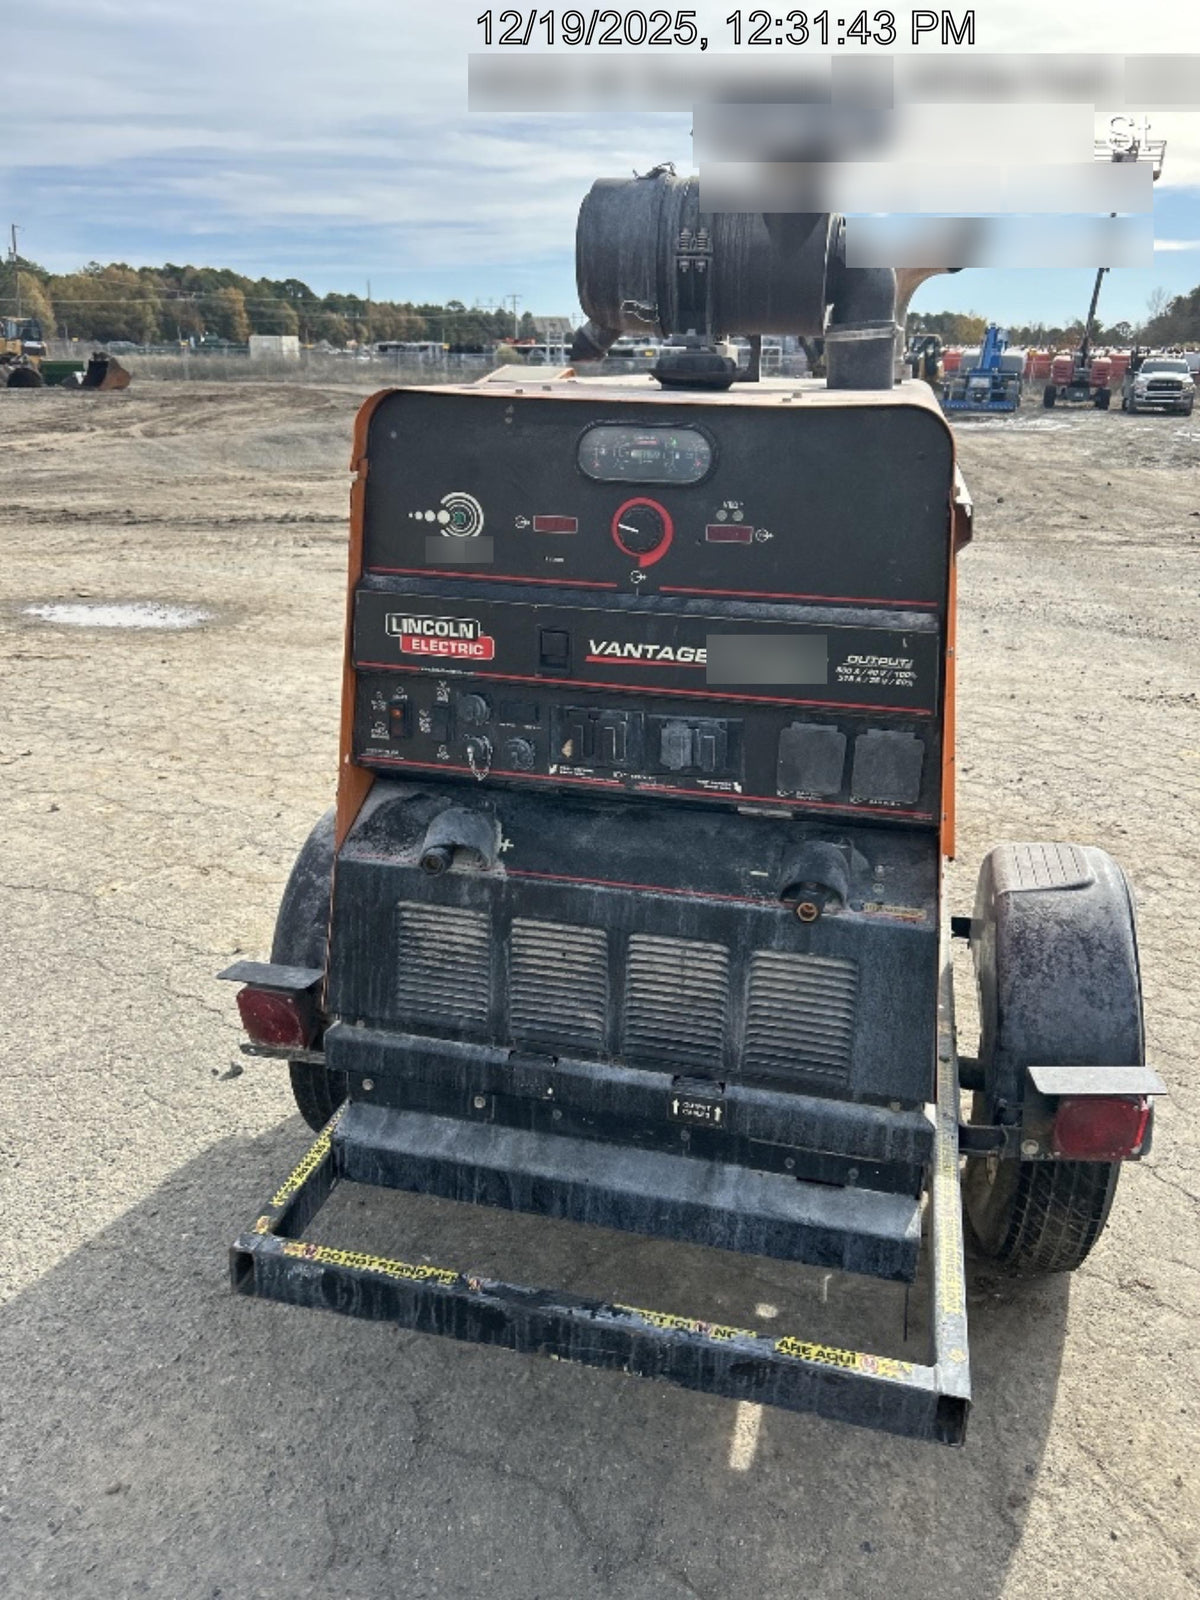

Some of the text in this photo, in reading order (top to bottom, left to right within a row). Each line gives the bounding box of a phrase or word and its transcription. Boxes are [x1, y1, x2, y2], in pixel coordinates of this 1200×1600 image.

[391, 616, 475, 639] LINCOLN
[411, 638, 485, 656] ELECTRIC
[589, 639, 707, 664] VANTAGE
[320, 1251, 342, 1261] DO
[343, 1255, 376, 1266] NOT
